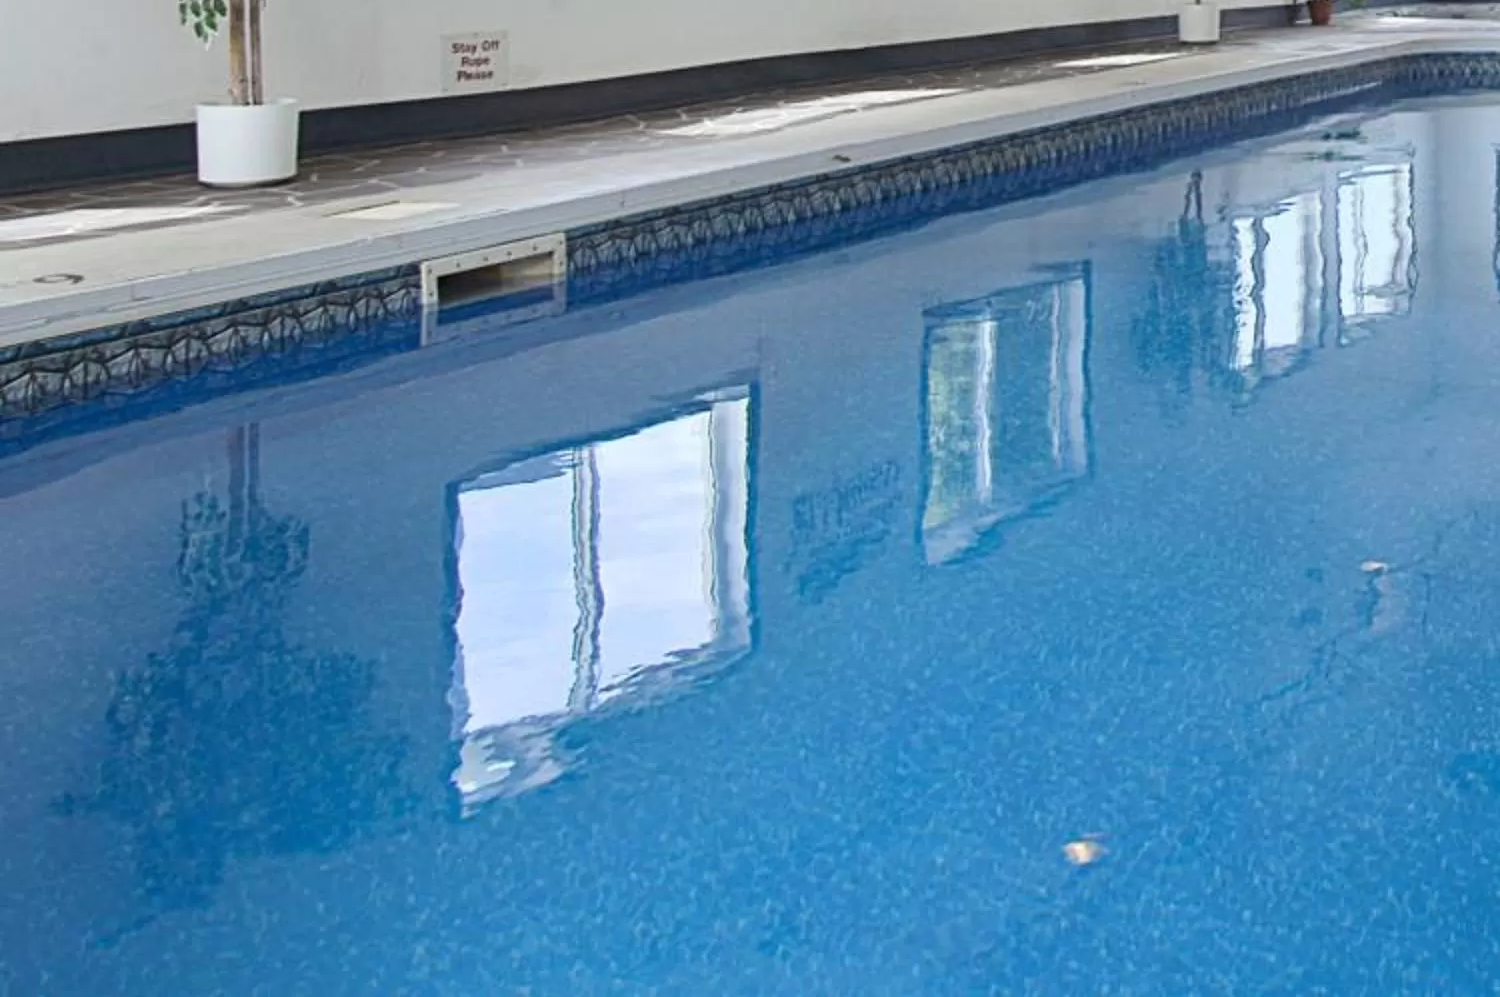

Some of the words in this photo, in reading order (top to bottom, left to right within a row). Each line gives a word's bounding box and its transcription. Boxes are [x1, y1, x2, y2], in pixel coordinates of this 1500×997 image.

[451, 42, 477, 55] Stay
[481, 39, 500, 52] Off
[456, 70, 494, 83] Please
